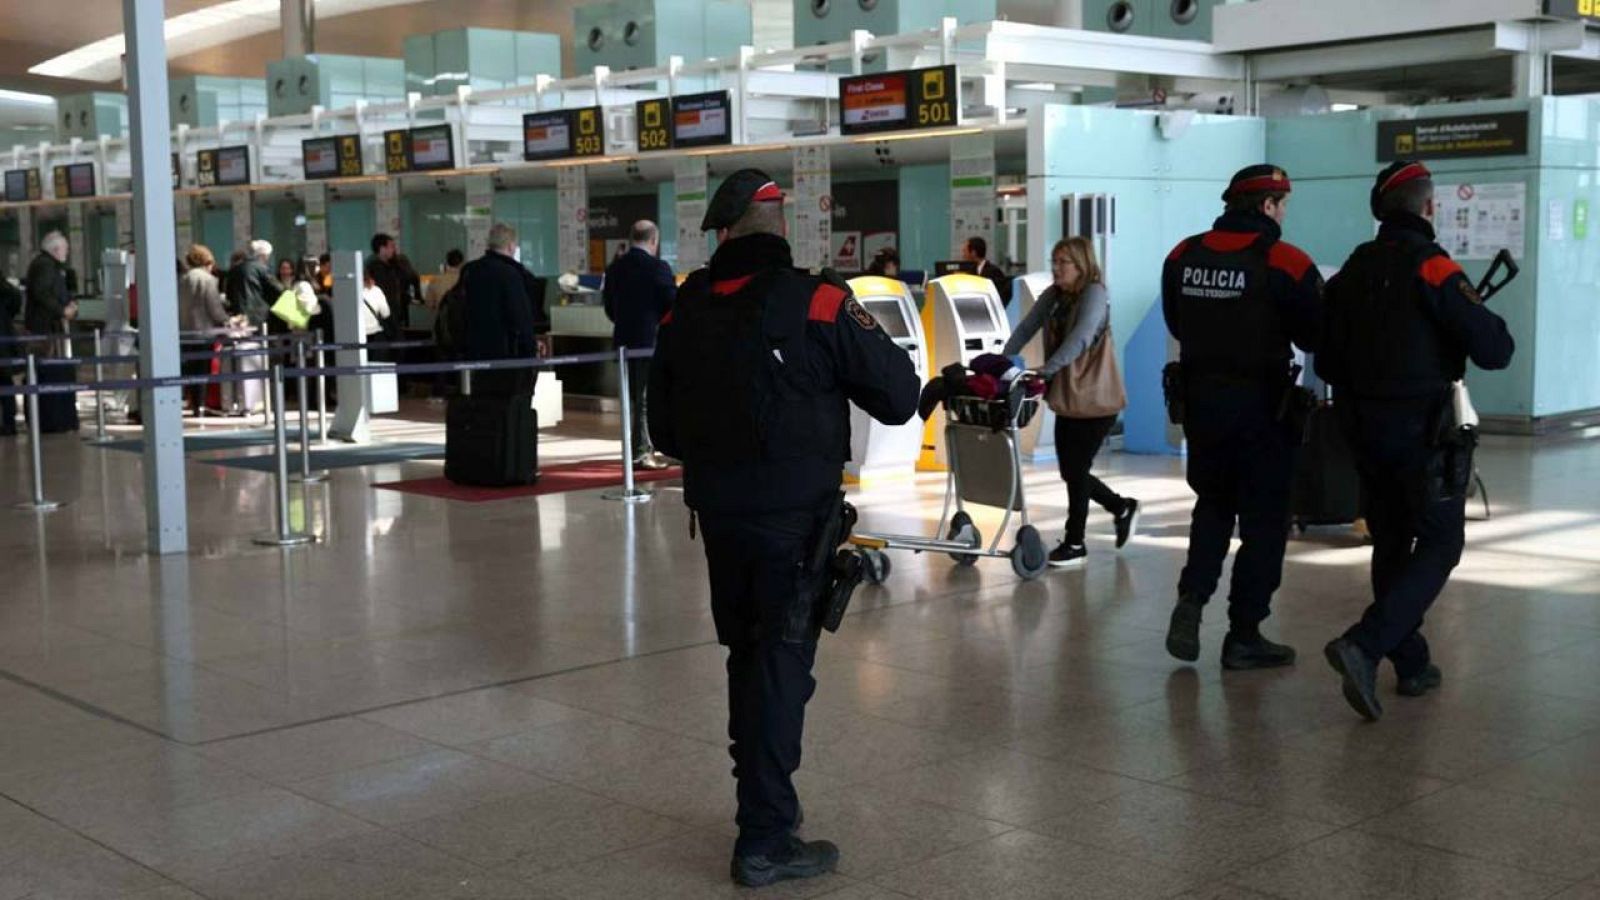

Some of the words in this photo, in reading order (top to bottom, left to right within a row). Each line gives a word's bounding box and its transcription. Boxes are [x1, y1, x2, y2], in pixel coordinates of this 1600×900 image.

[918, 102, 951, 124] 501
[575, 136, 600, 154] 503
[640, 129, 668, 148] 502
[1182, 266, 1246, 289] POLICIA
